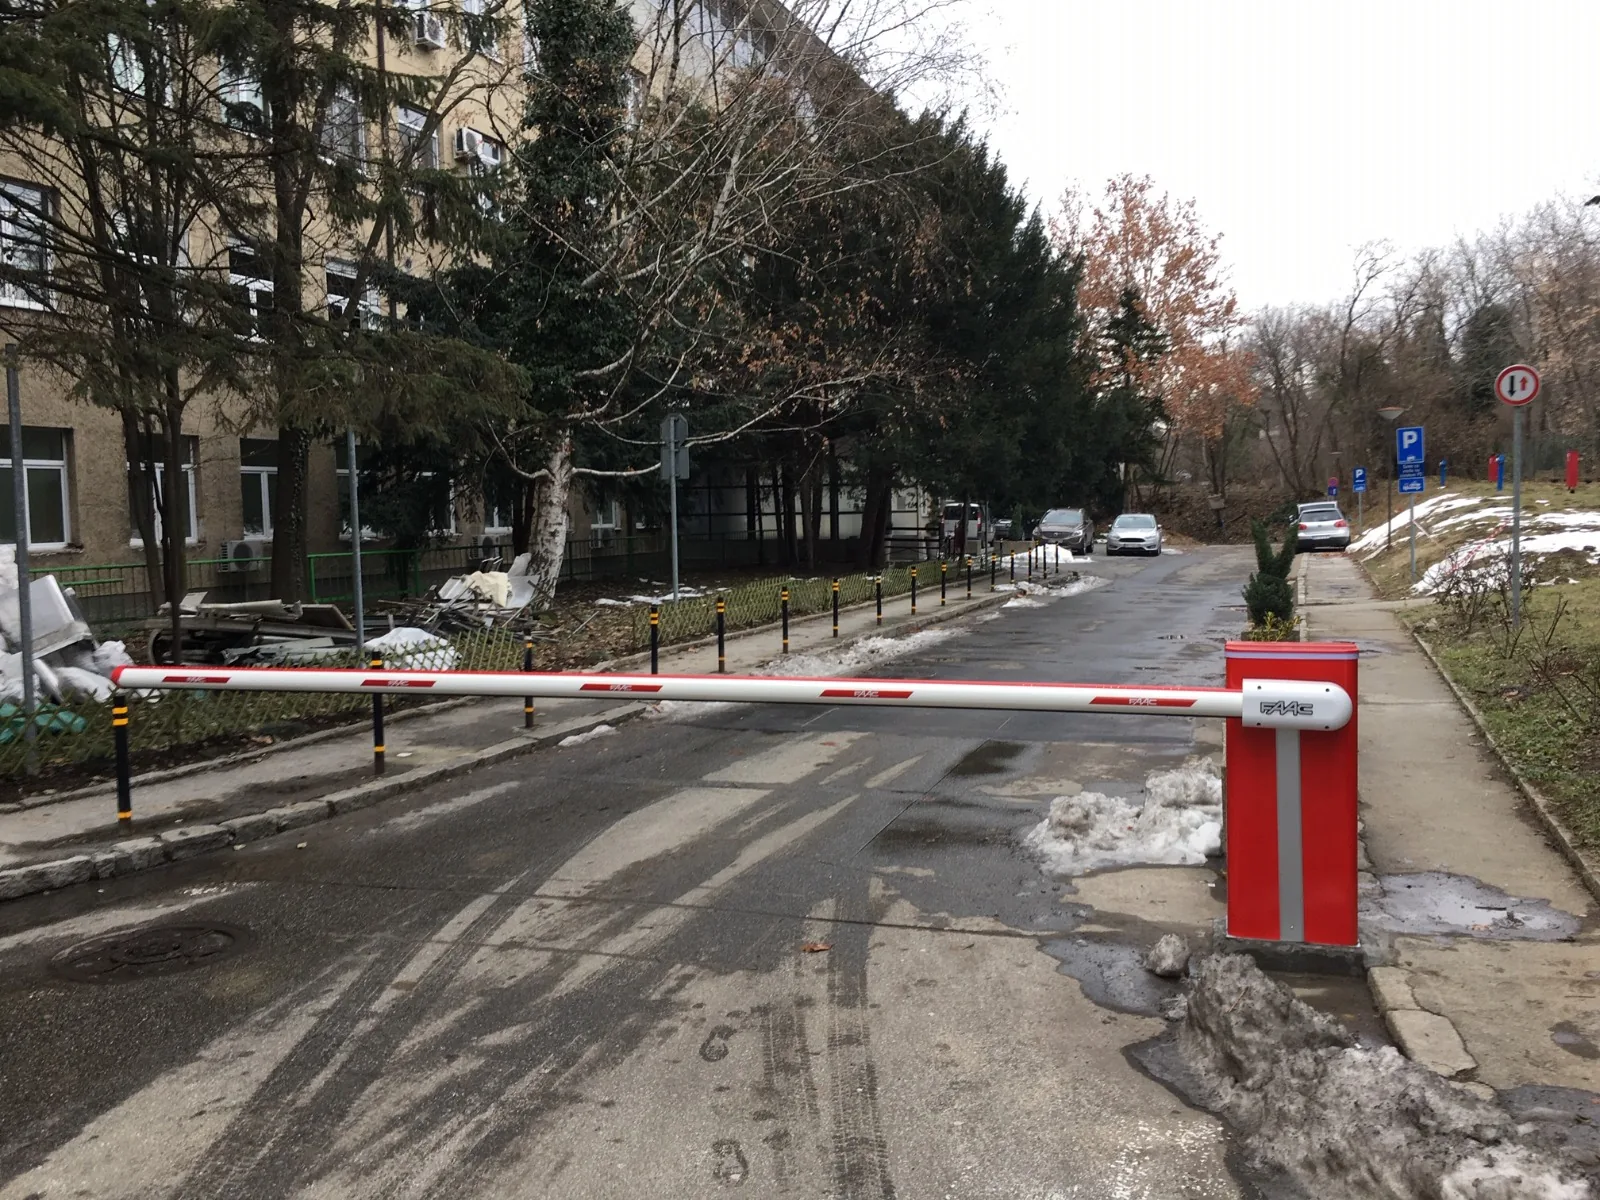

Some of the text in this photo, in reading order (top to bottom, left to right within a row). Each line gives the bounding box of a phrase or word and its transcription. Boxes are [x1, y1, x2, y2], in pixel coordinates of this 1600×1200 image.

[1403, 431, 1418, 449] P
[854, 690, 879, 698] FAAC
[1129, 698, 1157, 706] FAAC
[1260, 701, 1313, 716] FAAC
